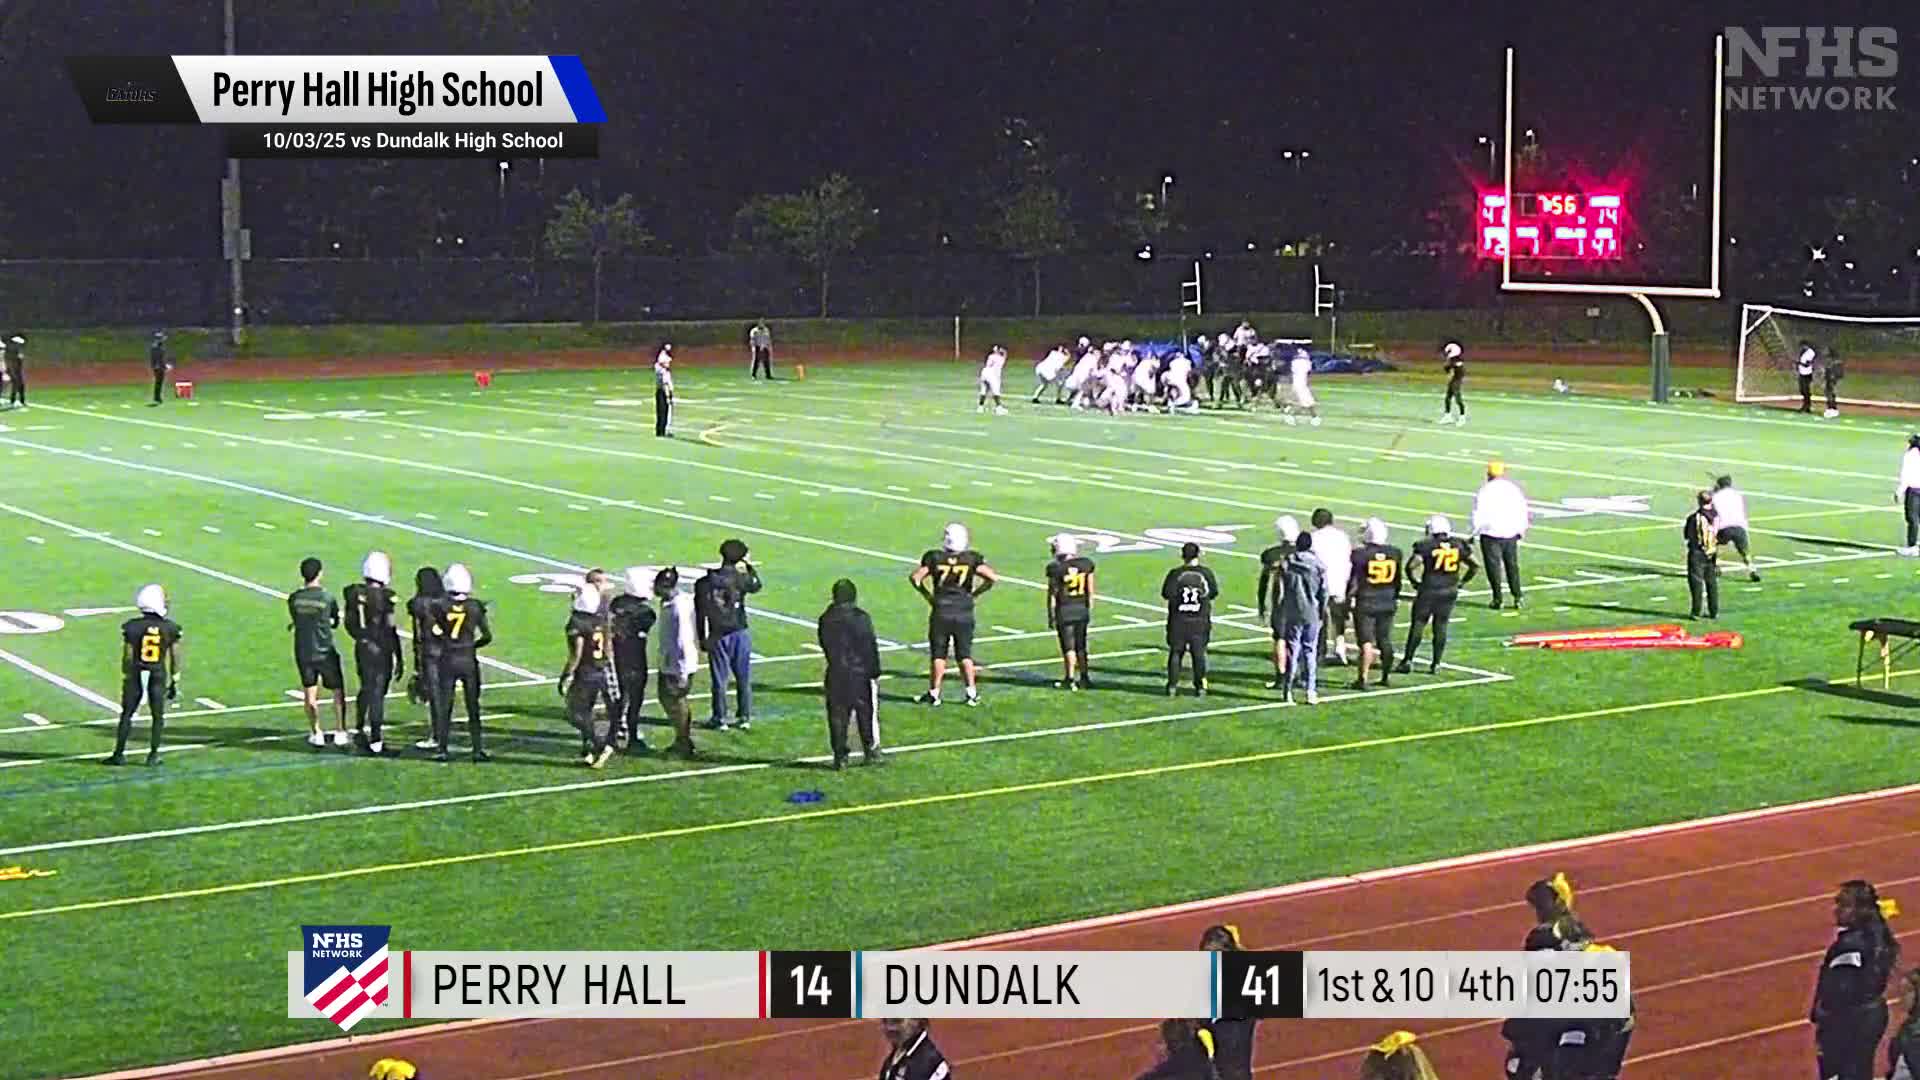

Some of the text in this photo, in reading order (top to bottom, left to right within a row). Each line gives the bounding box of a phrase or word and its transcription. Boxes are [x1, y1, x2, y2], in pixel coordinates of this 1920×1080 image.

[1366, 559, 1398, 585] 50
[1432, 548, 1460, 572] 72
[936, 564, 970, 590] 77
[445, 612, 467, 640] 7
[140, 634, 162, 663] 6
